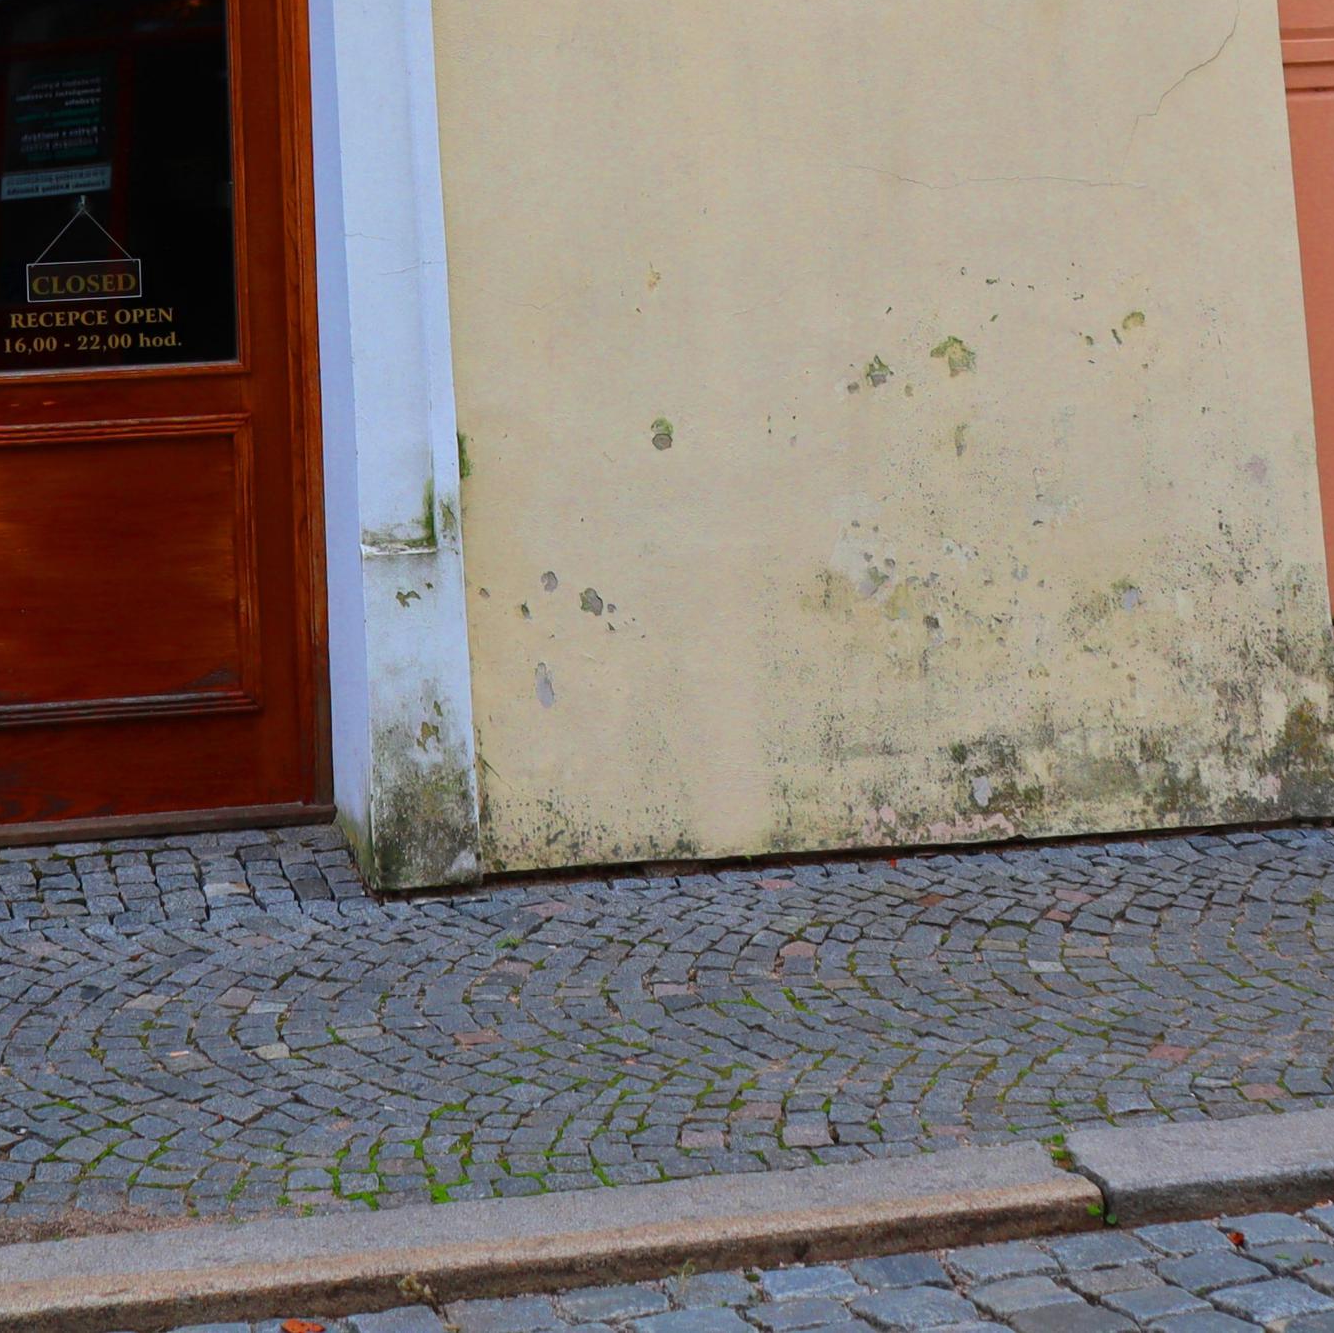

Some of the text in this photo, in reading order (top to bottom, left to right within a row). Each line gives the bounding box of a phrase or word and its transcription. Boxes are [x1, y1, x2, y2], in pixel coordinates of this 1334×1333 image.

[31, 273, 137, 296] CLOSED
[9, 307, 174, 329] RECEPCE OPEN
[4, 336, 58, 356] 16,00
[77, 333, 132, 353] 22,00
[139, 331, 183, 349] hod.
